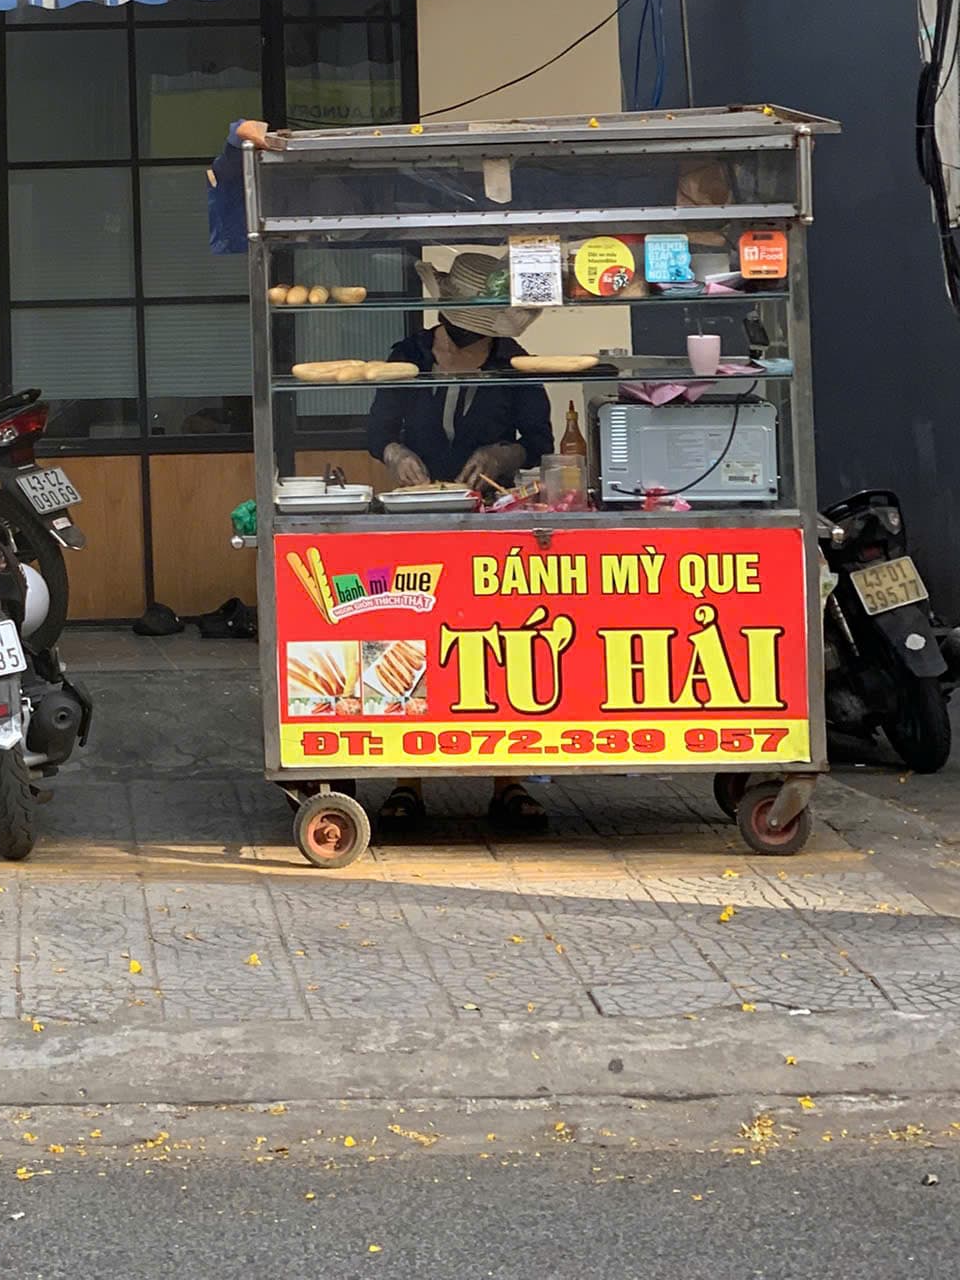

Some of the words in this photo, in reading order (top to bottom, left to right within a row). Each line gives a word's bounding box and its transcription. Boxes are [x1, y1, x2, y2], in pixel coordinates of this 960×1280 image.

[26, 470, 64, 492] 43-C2
[32, 485, 78, 510] 090.69
[472, 547, 588, 596] BÁNH
[600, 545, 665, 595] MỲ
[678, 552, 761, 599] QUE
[336, 579, 365, 603] bánh
[370, 576, 388, 595] mì
[395, 571, 431, 592] que
[402, 593, 433, 609] THẬT
[440, 604, 576, 716] TỨ
[596, 604, 788, 714] HẢI
[300, 730, 384, 757] ĐT:
[402, 728, 666, 756] 0972.339
[684, 728, 790, 753] 957
